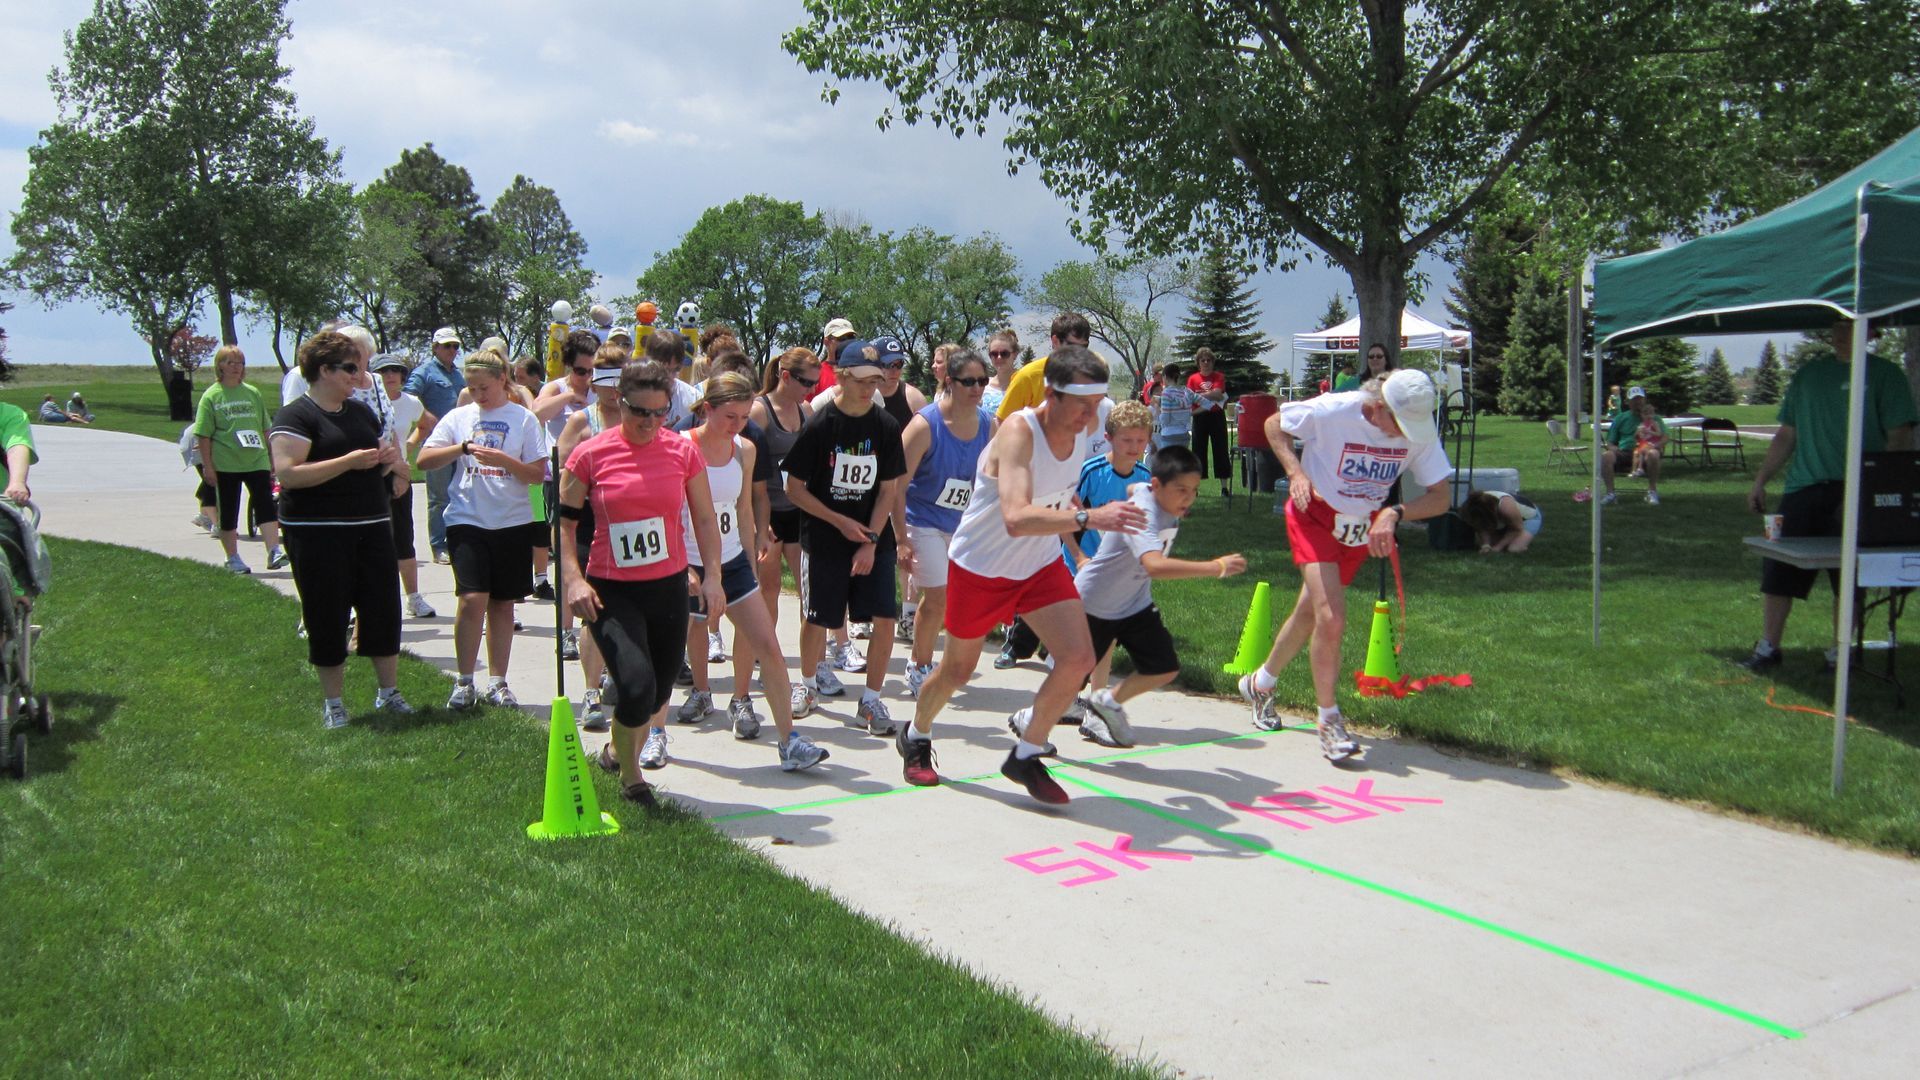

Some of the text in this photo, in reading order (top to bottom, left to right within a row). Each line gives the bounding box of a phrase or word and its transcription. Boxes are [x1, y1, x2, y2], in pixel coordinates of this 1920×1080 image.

[243, 434, 260, 445] 185
[840, 463, 871, 485] 182
[1343, 458, 1401, 480] 2 RUN
[944, 487, 970, 506] 159
[1874, 494, 1902, 507] HOME
[620, 530, 661, 561] 149
[1226, 778, 1444, 831] 10K
[1003, 834, 1194, 888] 5K
